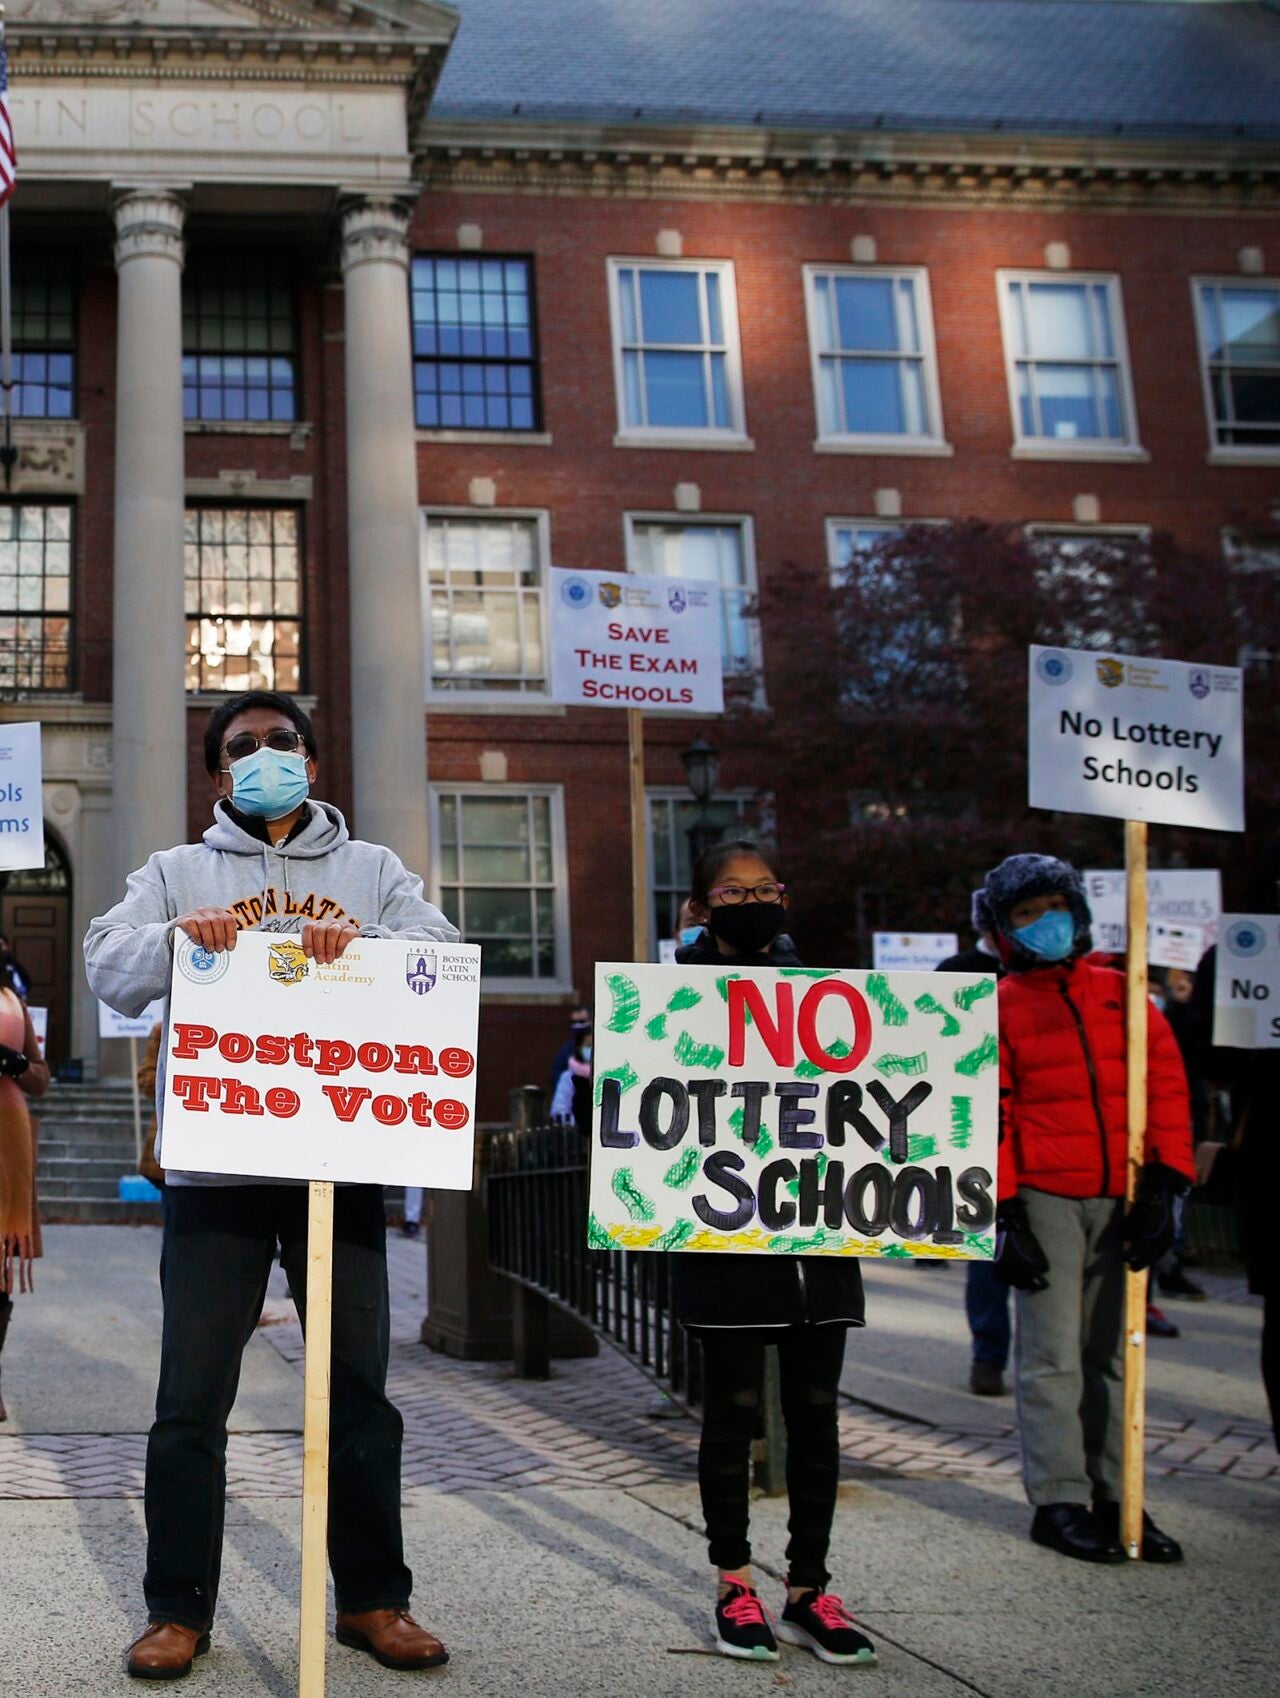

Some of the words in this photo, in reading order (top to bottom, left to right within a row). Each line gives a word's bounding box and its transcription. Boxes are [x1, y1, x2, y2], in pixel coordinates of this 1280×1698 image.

[130, 101, 364, 143] SCHOOL
[608, 622, 670, 643] SAVE
[574, 649, 623, 670] THE
[630, 653, 697, 674] EXAM
[582, 679, 694, 704] SCHOOLS
[1060, 709, 1103, 738] No
[1113, 716, 1223, 758] Lottery
[1082, 756, 1199, 793] Schools
[442, 955, 479, 965] BOSTON
[442, 964, 469, 973] LATIN
[313, 971, 375, 986] Academy
[441, 973, 478, 983] SCHOOL
[1232, 978, 1269, 1000] No
[726, 978, 872, 1074] NO
[172, 1022, 475, 1079] Postpone
[172, 1074, 301, 1119] The
[322, 1084, 470, 1130] Vote
[599, 1076, 933, 1165] LOTTERY
[691, 1150, 996, 1245] SCHOOLS
